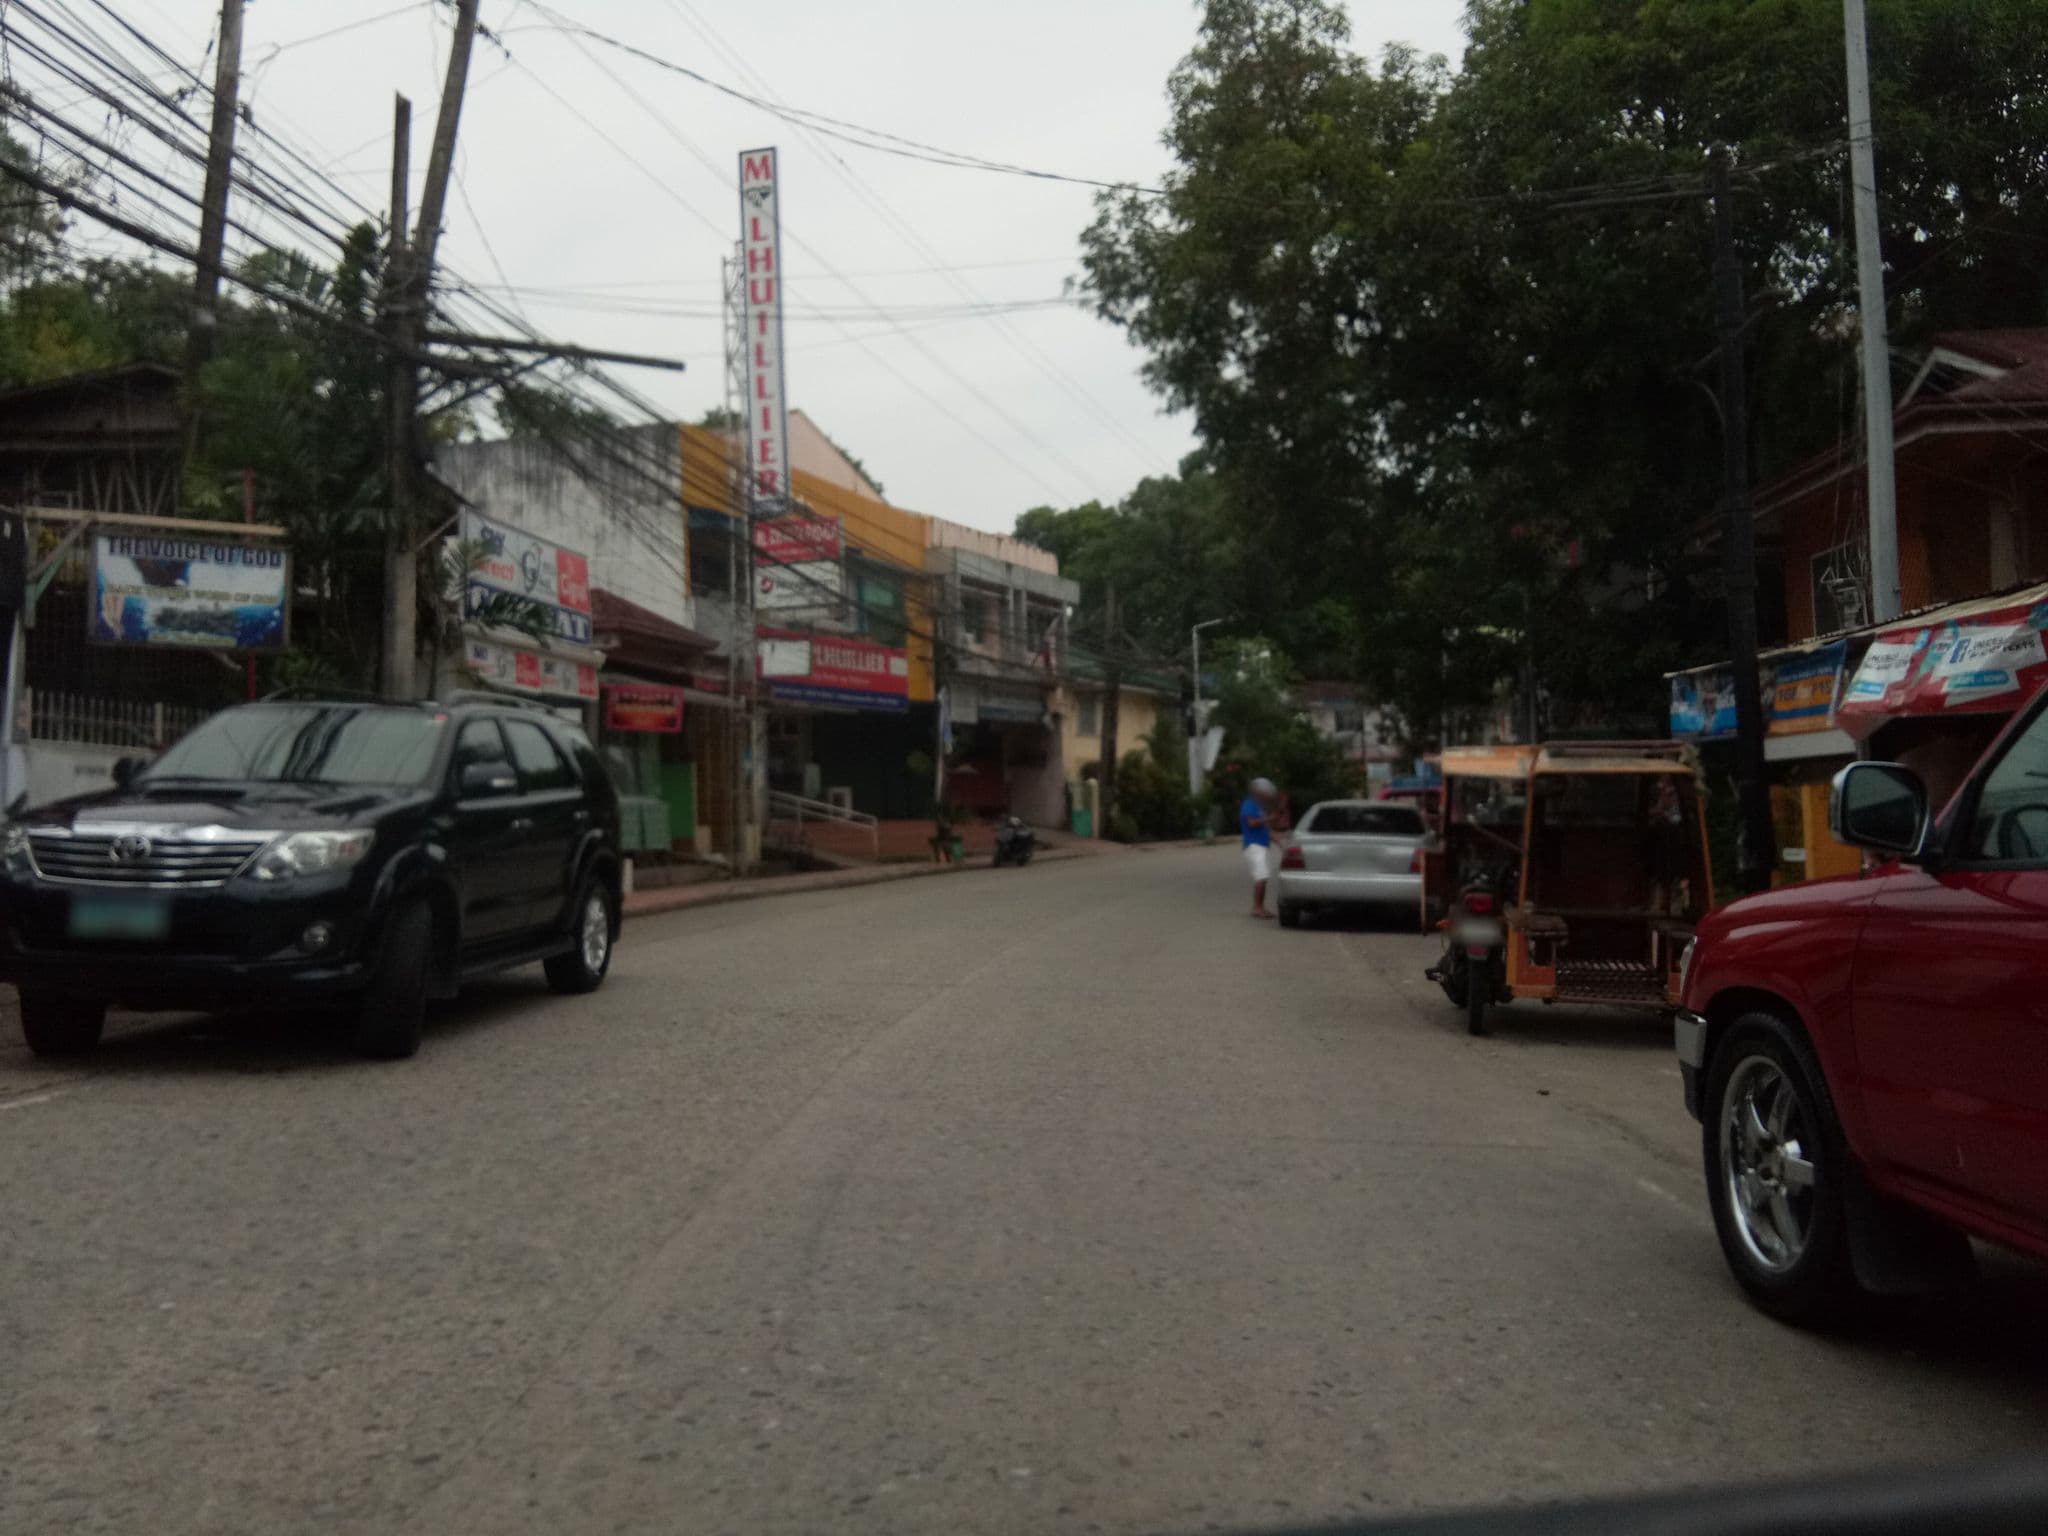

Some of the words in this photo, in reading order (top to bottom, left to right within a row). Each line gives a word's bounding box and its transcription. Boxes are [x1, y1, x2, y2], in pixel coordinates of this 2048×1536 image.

[744, 154, 774, 181] M
[748, 215, 779, 498] LHUILLIER
[108, 536, 143, 556] THE
[146, 539, 209, 562] VOICE
[212, 545, 239, 563] OF
[242, 547, 282, 567] GOD
